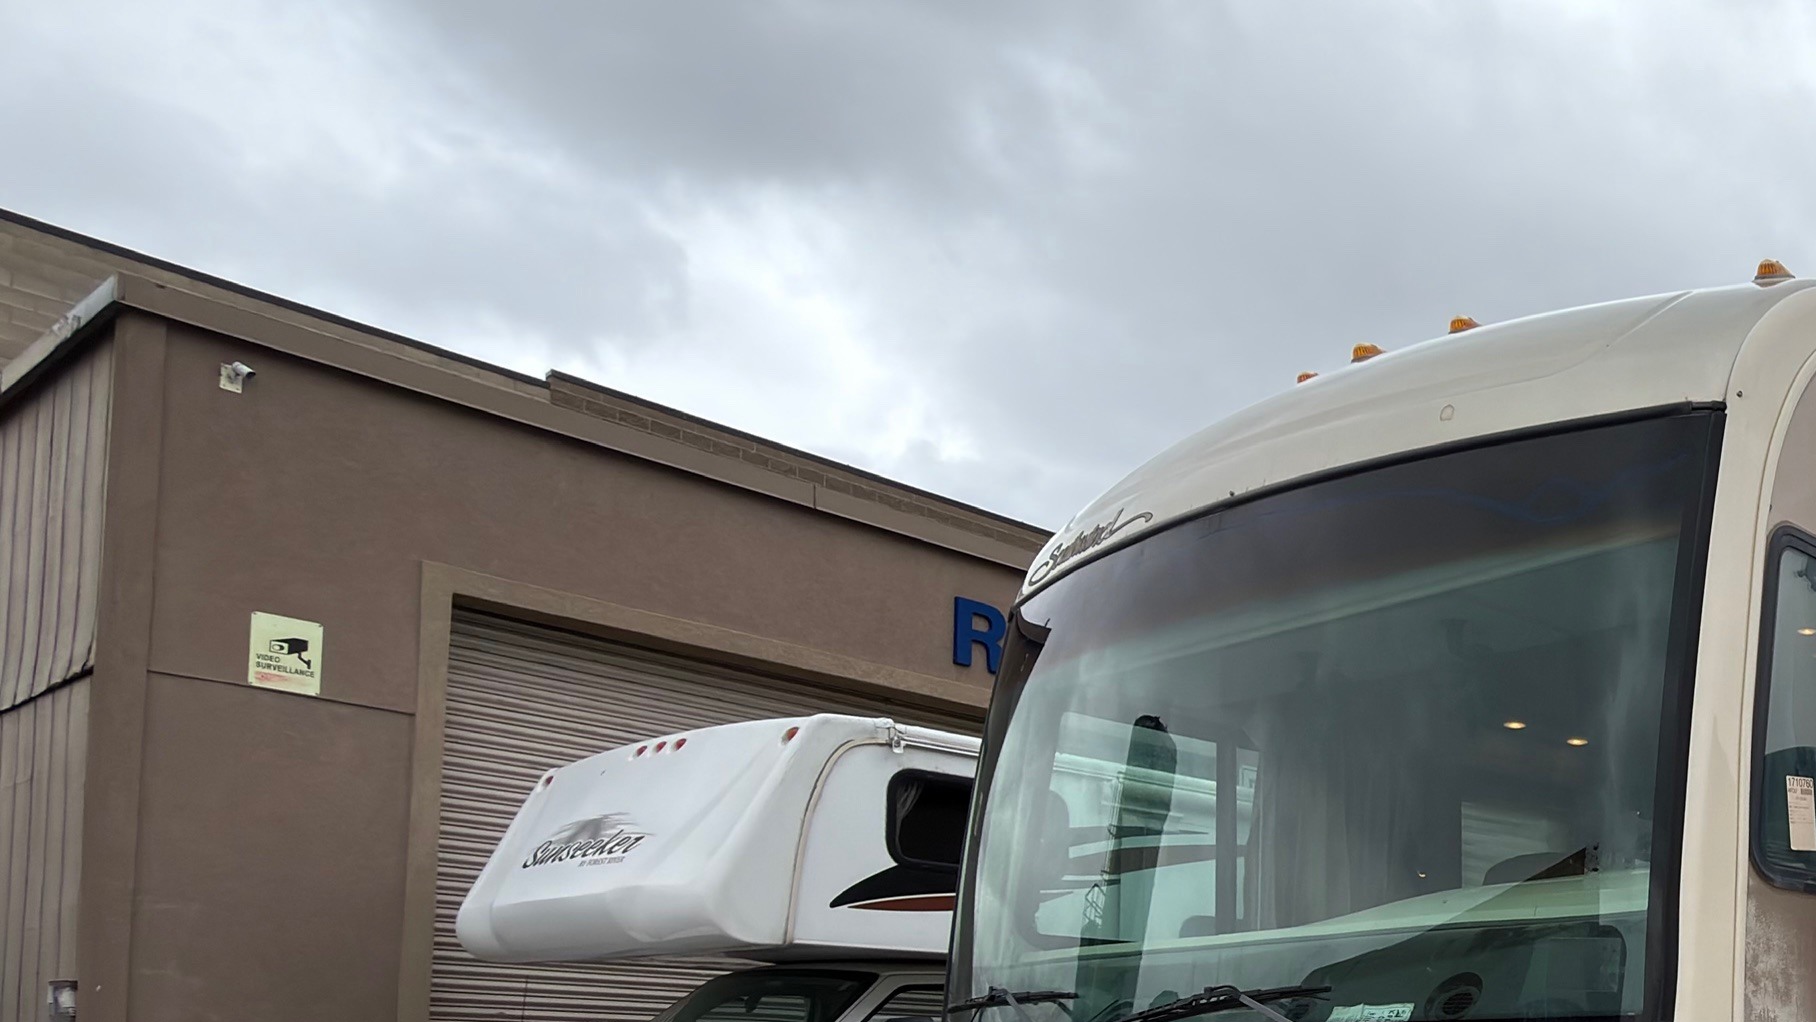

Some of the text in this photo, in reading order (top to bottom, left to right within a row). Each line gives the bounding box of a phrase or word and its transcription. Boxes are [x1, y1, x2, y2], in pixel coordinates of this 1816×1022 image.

[256, 653, 281, 663] VIDEO
[256, 661, 315, 678] SURVEILLANCE
[522, 829, 645, 869] Sunseeker
